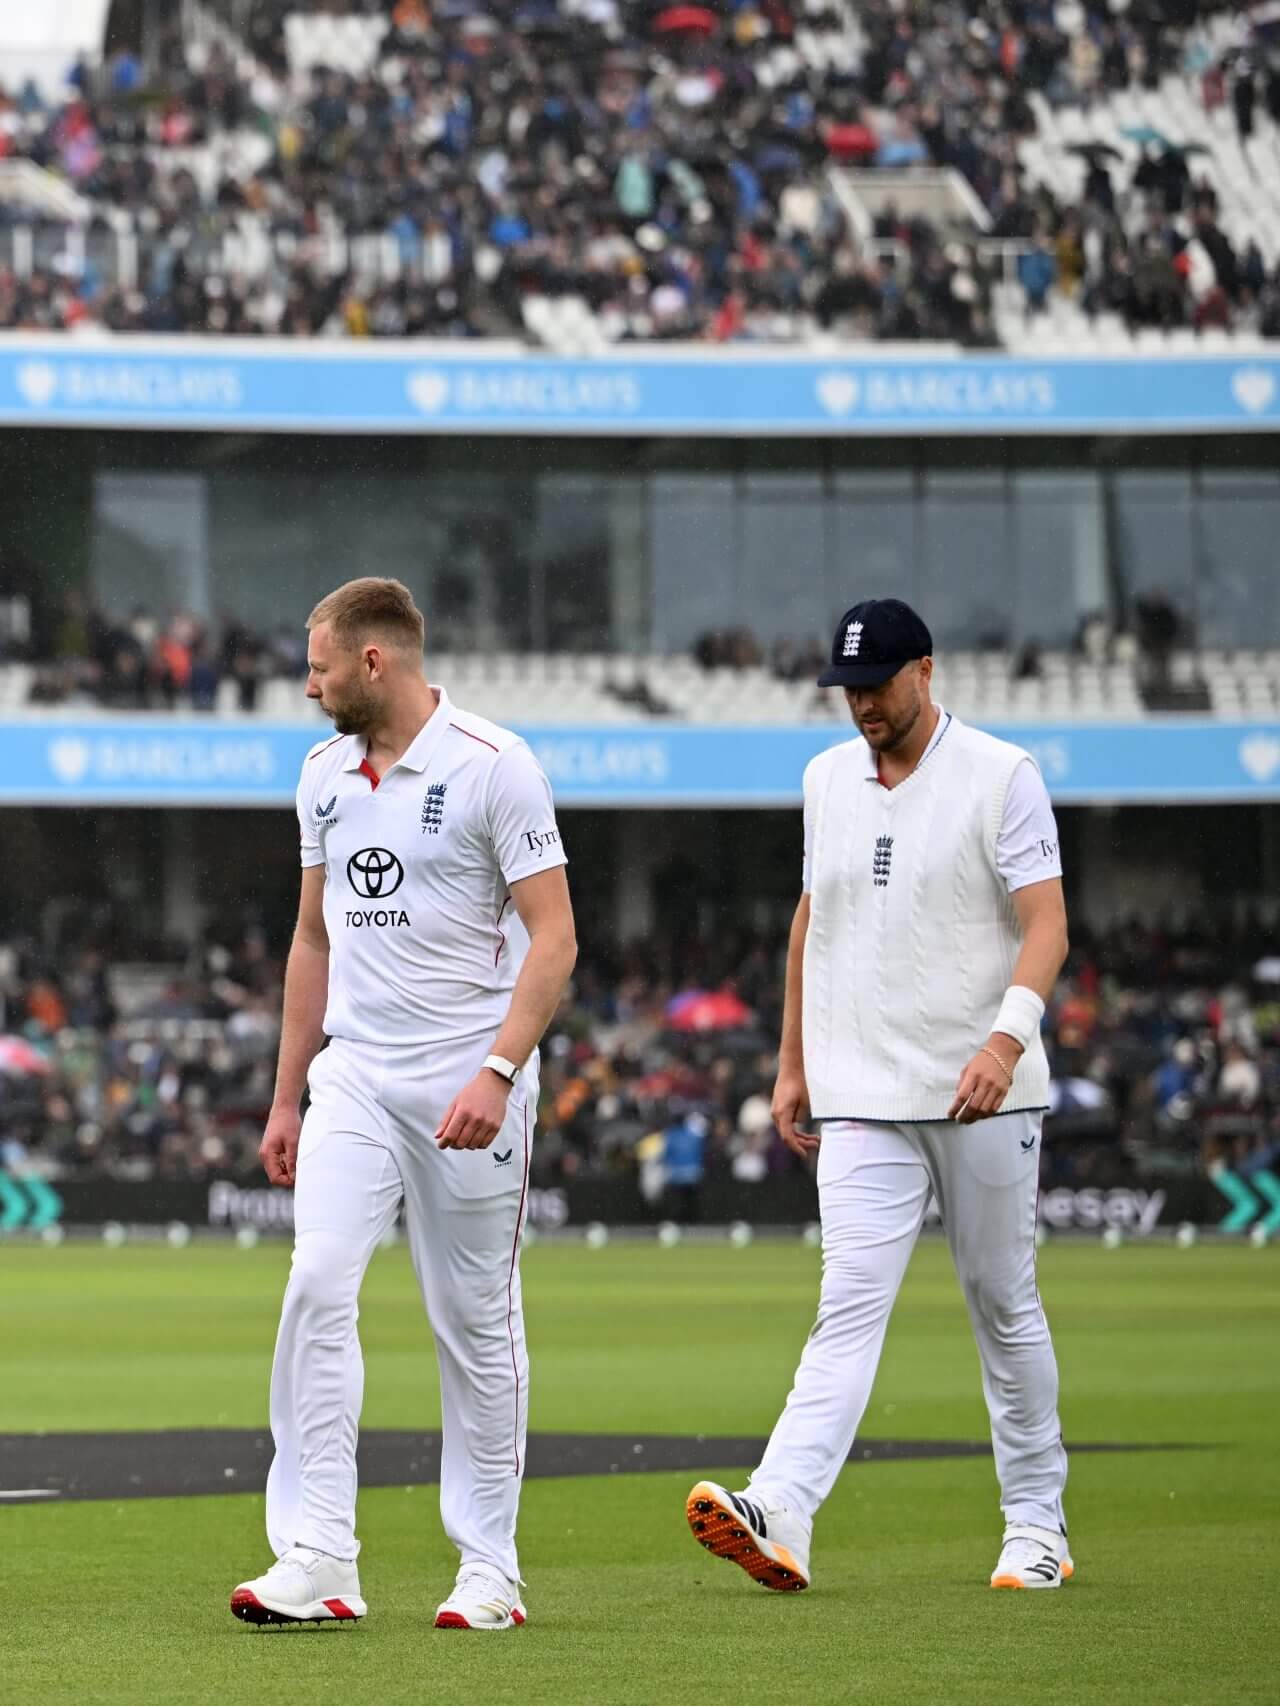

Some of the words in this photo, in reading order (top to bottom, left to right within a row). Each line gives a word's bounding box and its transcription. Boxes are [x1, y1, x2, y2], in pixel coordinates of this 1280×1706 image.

[455, 370, 640, 413] BARCLAYS
[866, 371, 1055, 413] BARCLAYS
[421, 826, 439, 835] 714
[345, 911, 411, 928] TOYOTA
